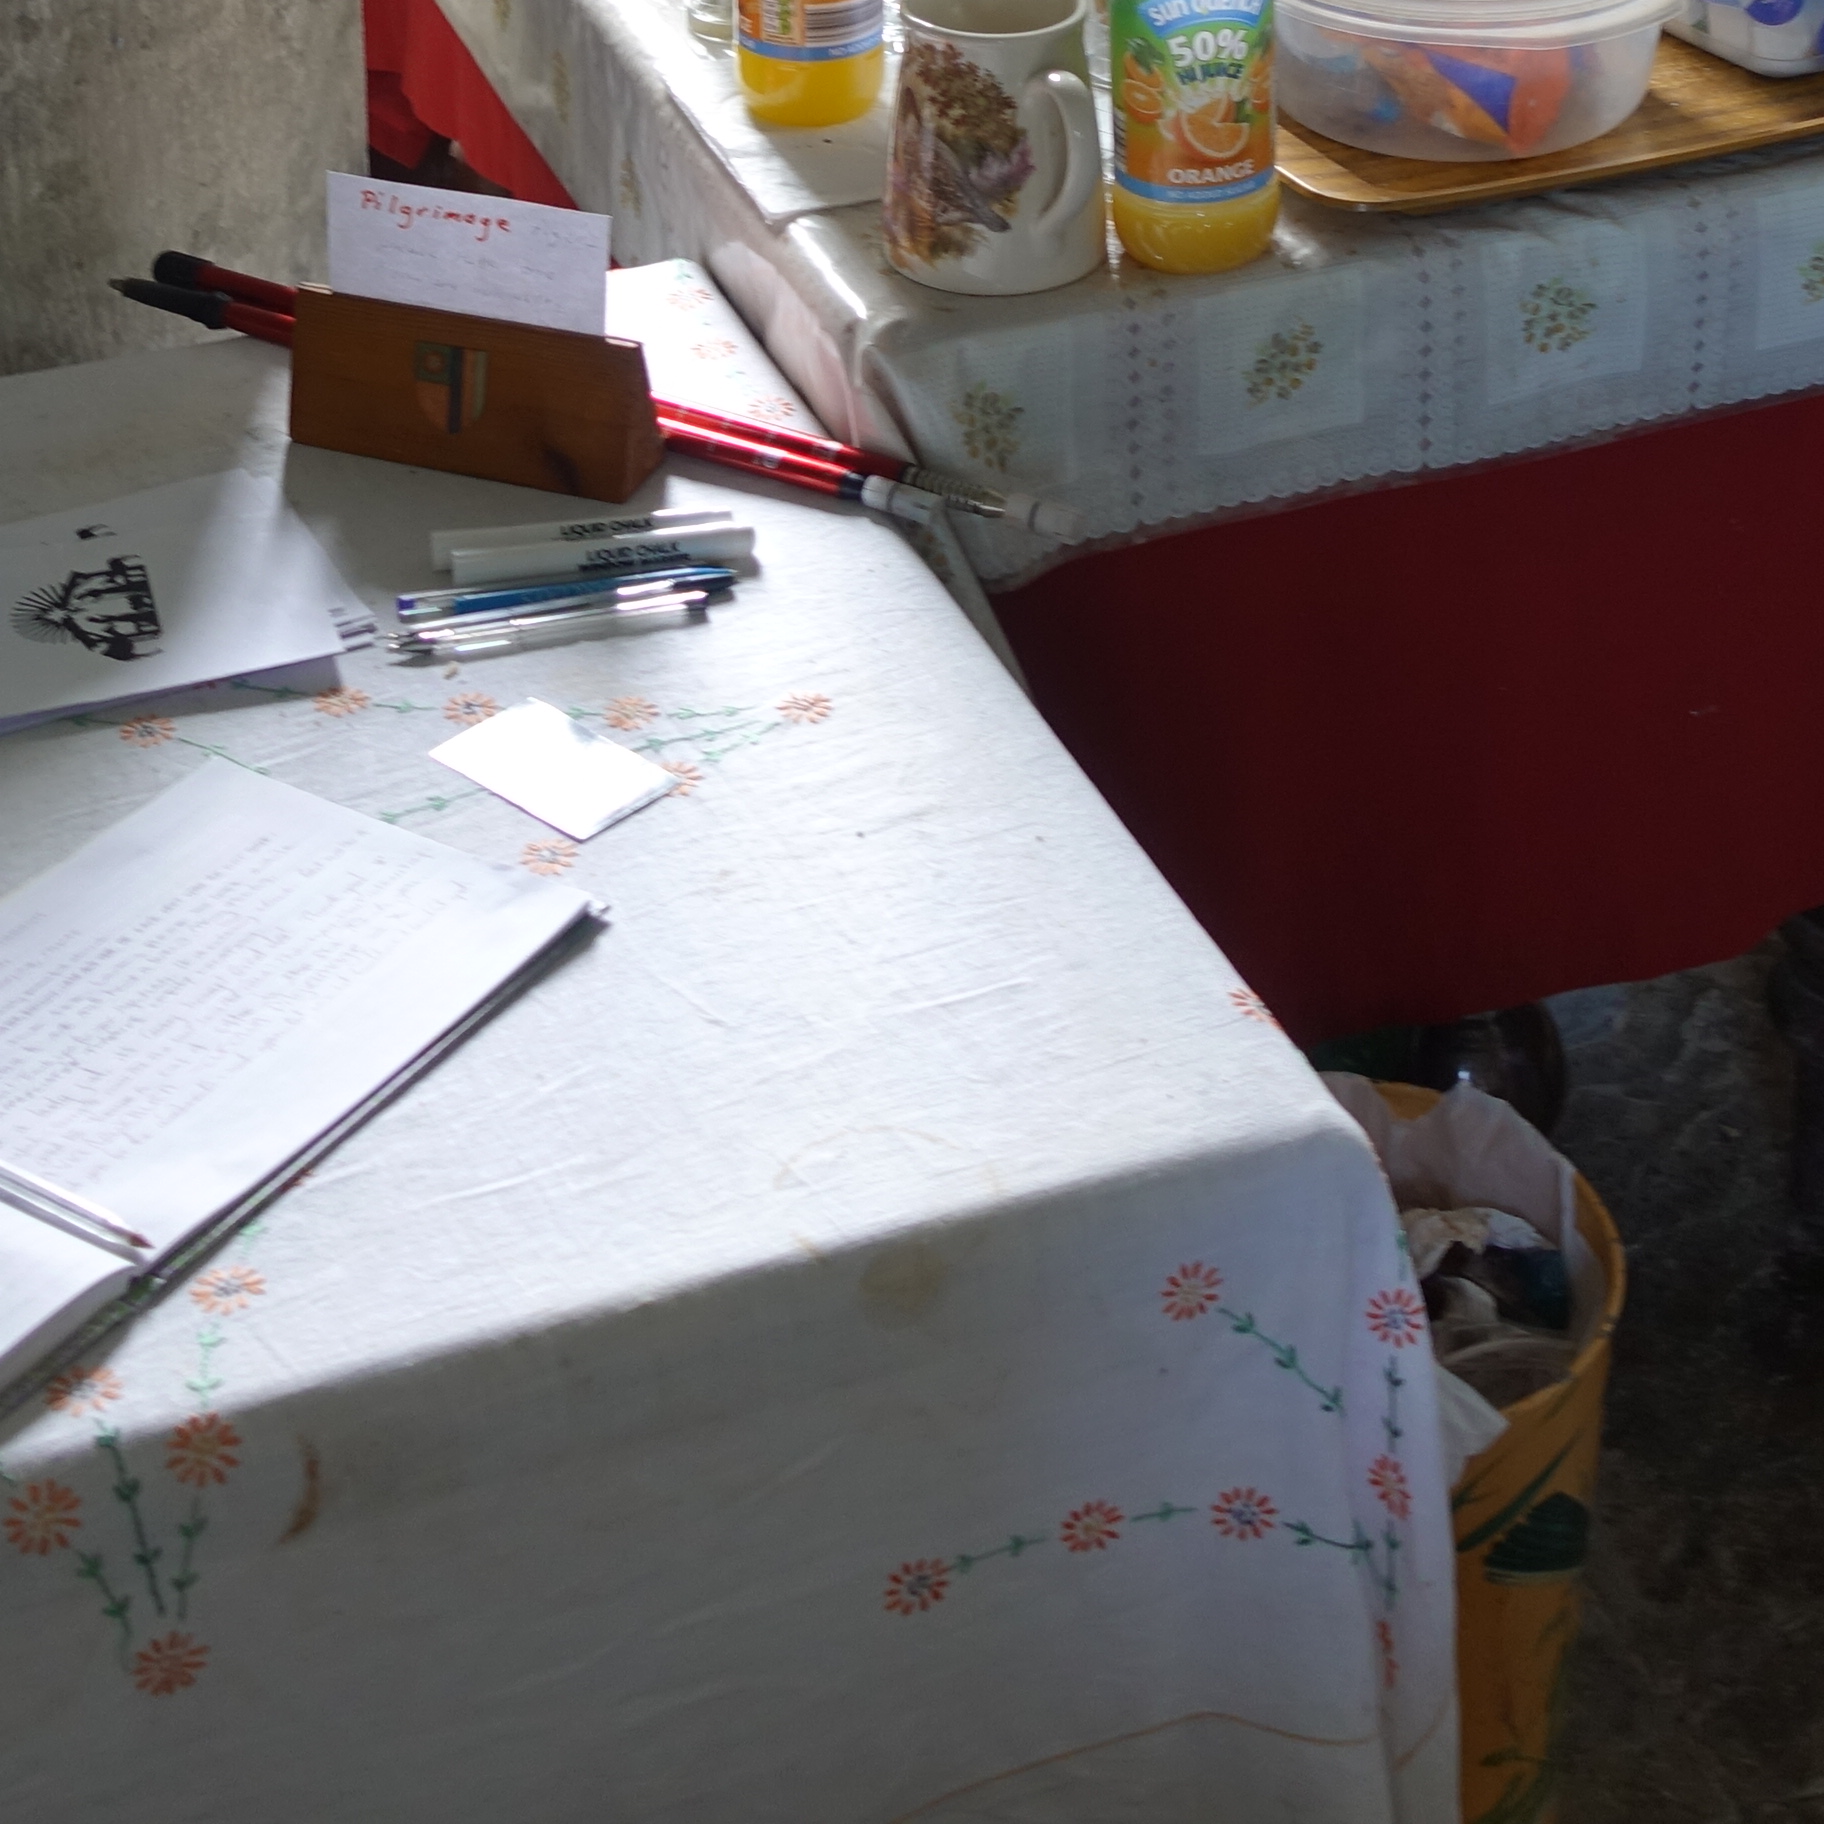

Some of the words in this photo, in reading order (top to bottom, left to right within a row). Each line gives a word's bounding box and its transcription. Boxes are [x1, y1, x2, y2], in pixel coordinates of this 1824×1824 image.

[1164, 27, 1250, 68] 50%
[1165, 157, 1256, 185] ORANGE
[360, 188, 512, 242] Pilgrimage
[559, 521, 607, 537] LIQUID
[608, 516, 654, 532] CHALK
[585, 545, 633, 562] LIQUID
[635, 540, 681, 557] CHALK
